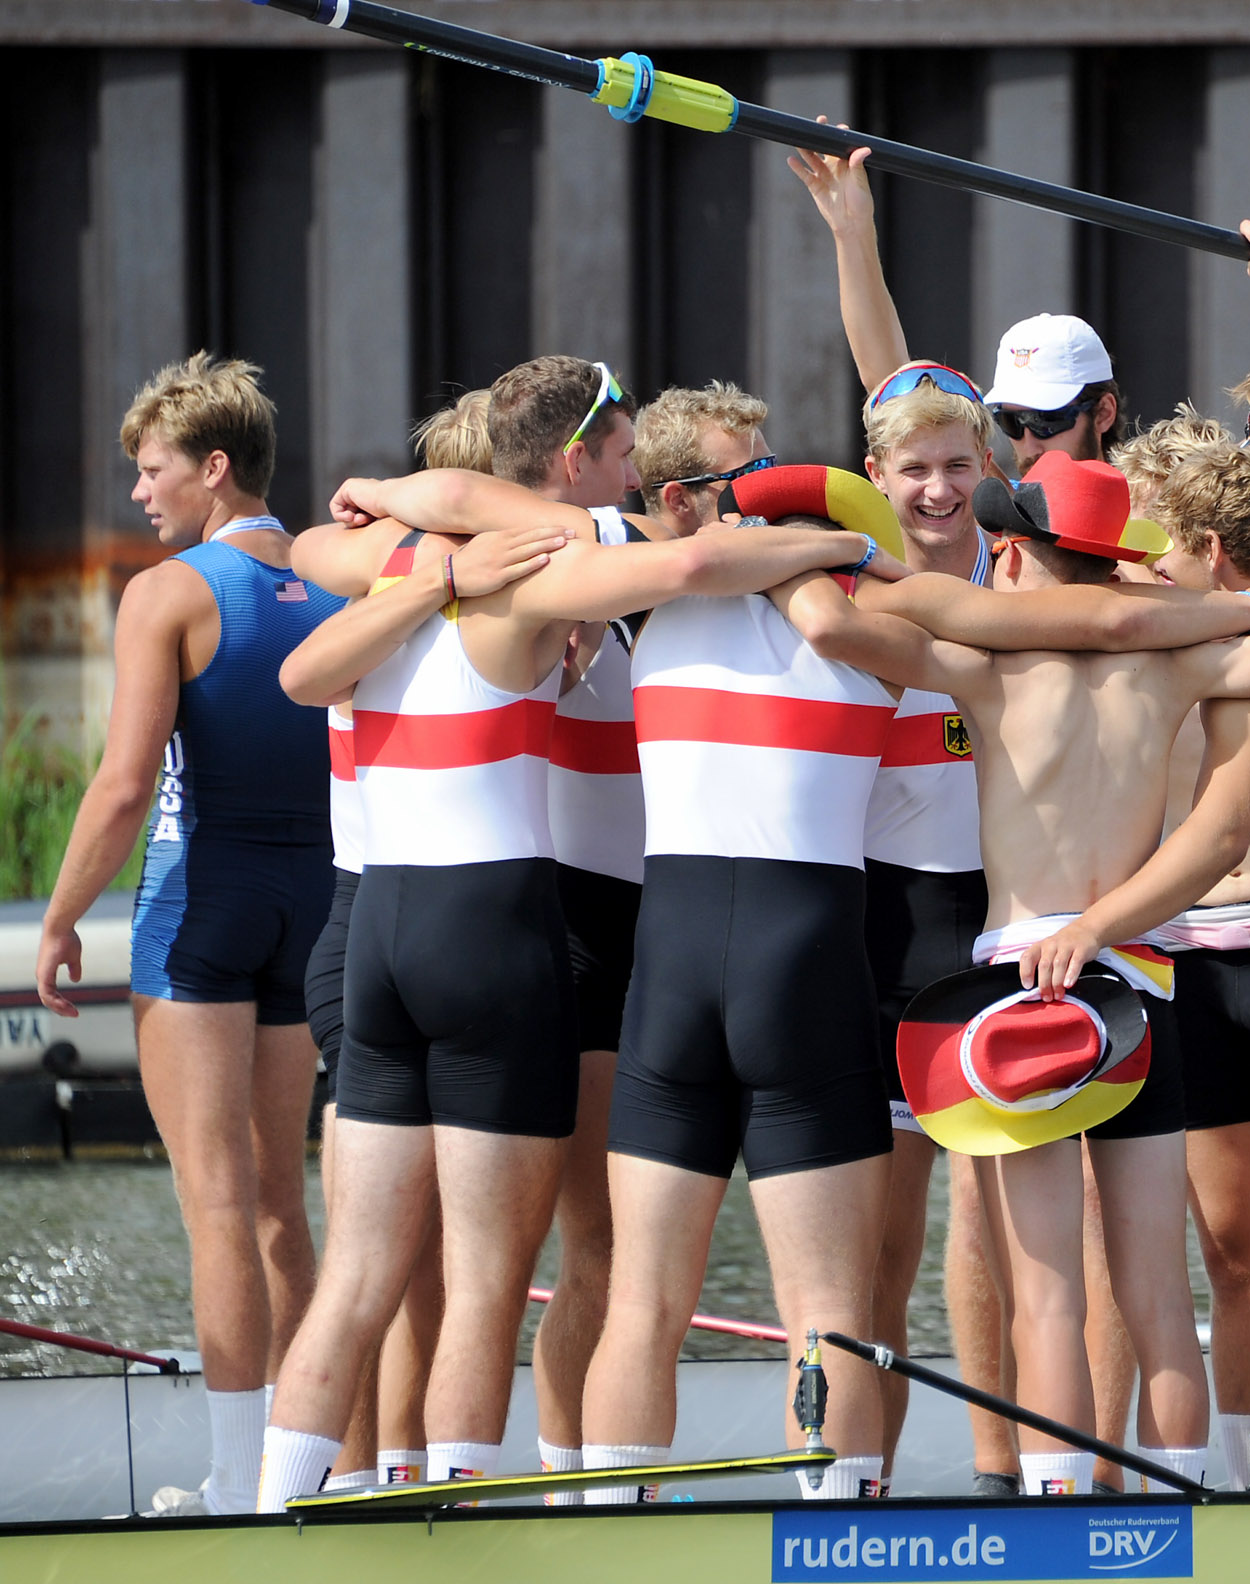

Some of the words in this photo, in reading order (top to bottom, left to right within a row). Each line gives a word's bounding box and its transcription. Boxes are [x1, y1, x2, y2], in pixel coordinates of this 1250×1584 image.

[1088, 1518, 1126, 1527] Deutscher
[1128, 1516, 1180, 1526] Ruderverband
[784, 1524, 1007, 1568] rudern.de
[1089, 1530, 1157, 1557] DRV
